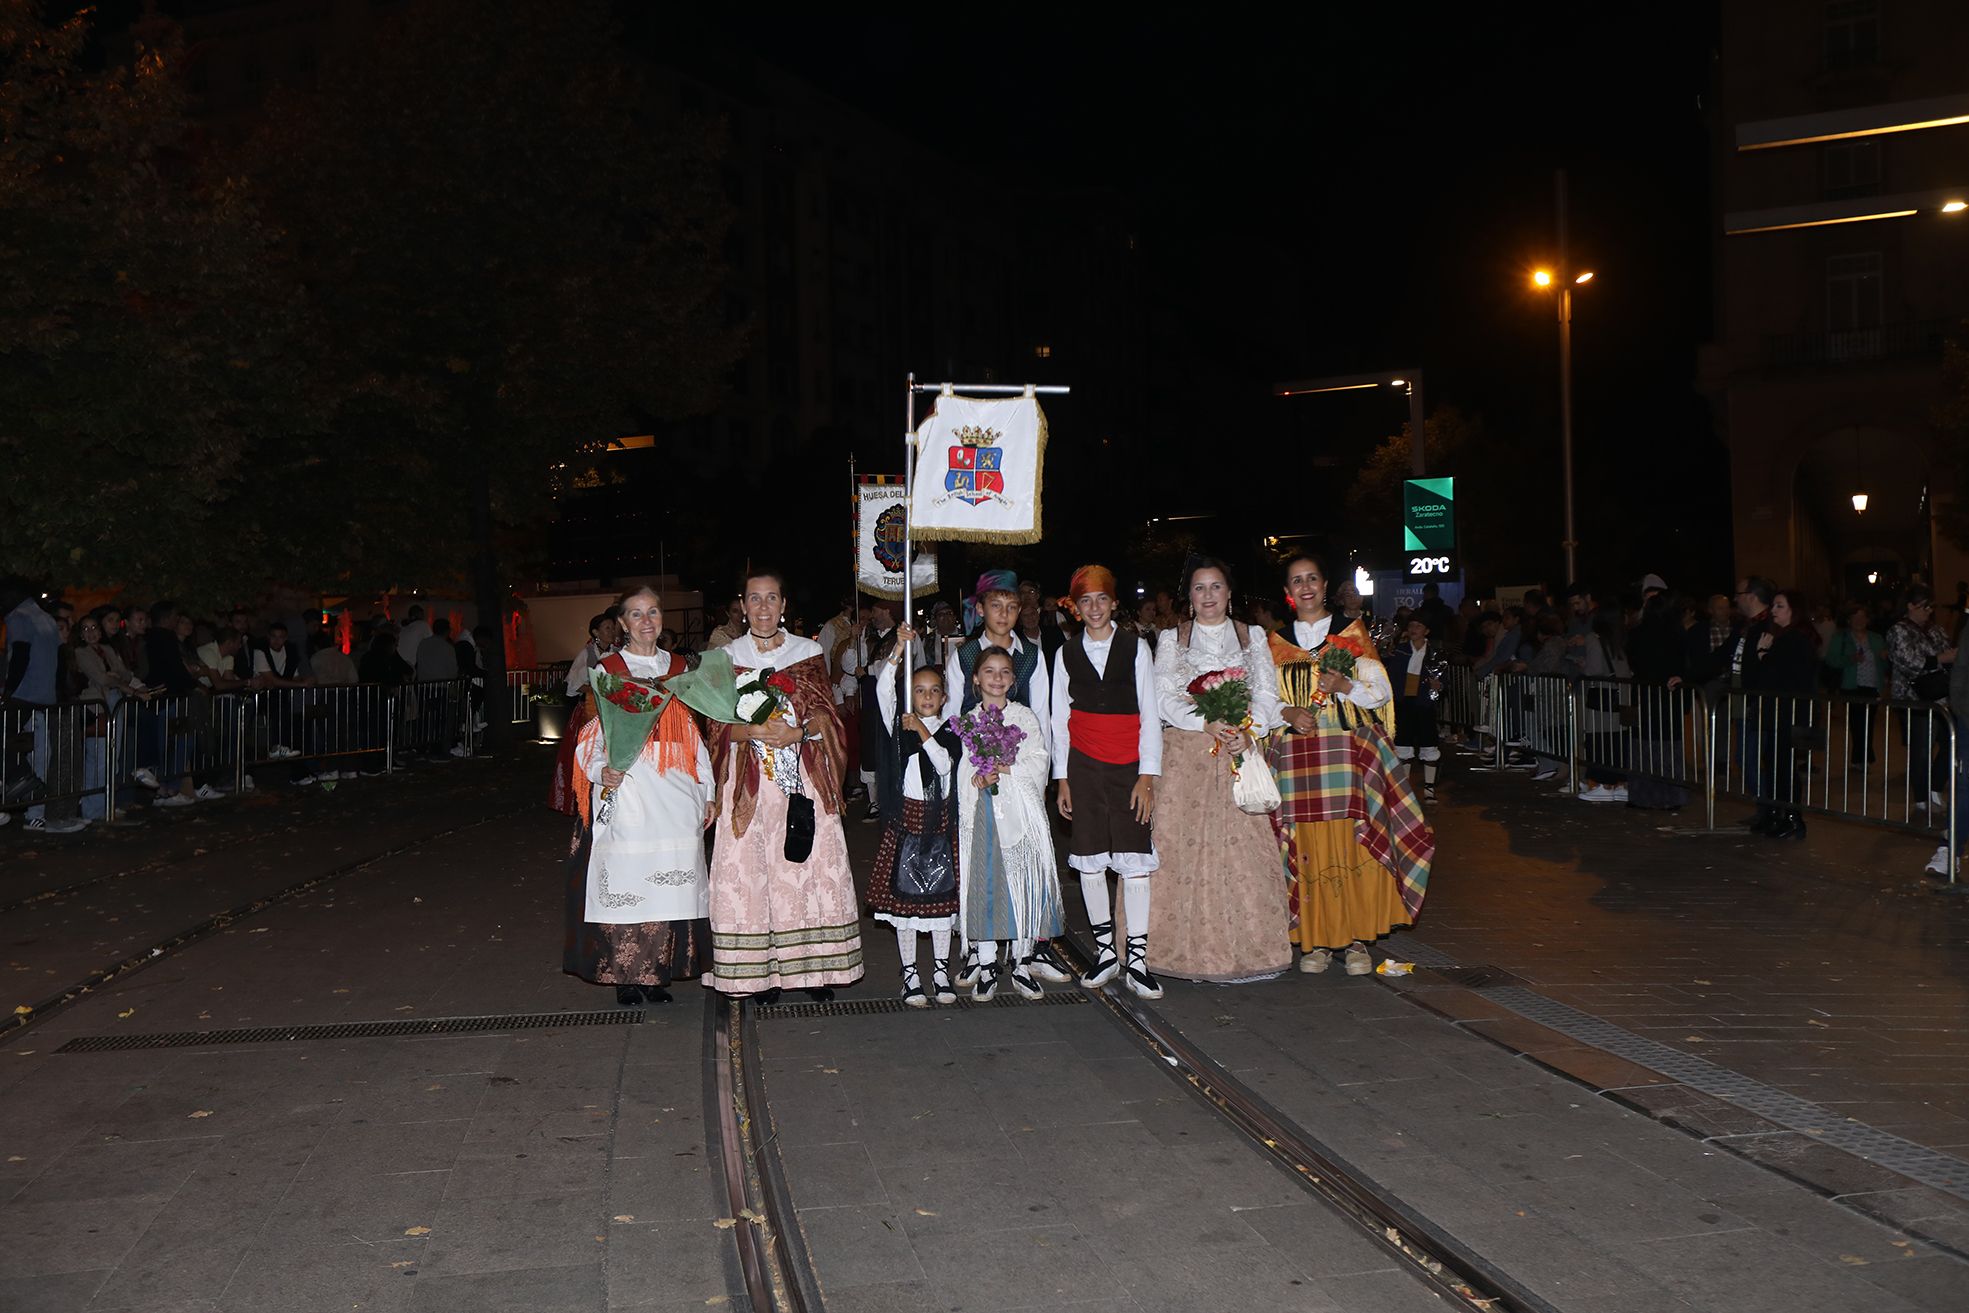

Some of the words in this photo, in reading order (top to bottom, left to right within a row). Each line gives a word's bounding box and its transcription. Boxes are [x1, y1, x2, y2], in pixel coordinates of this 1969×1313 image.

[863, 491, 889, 501] HUESA
[889, 490, 904, 499] DEL
[883, 576, 905, 585] TERUE
